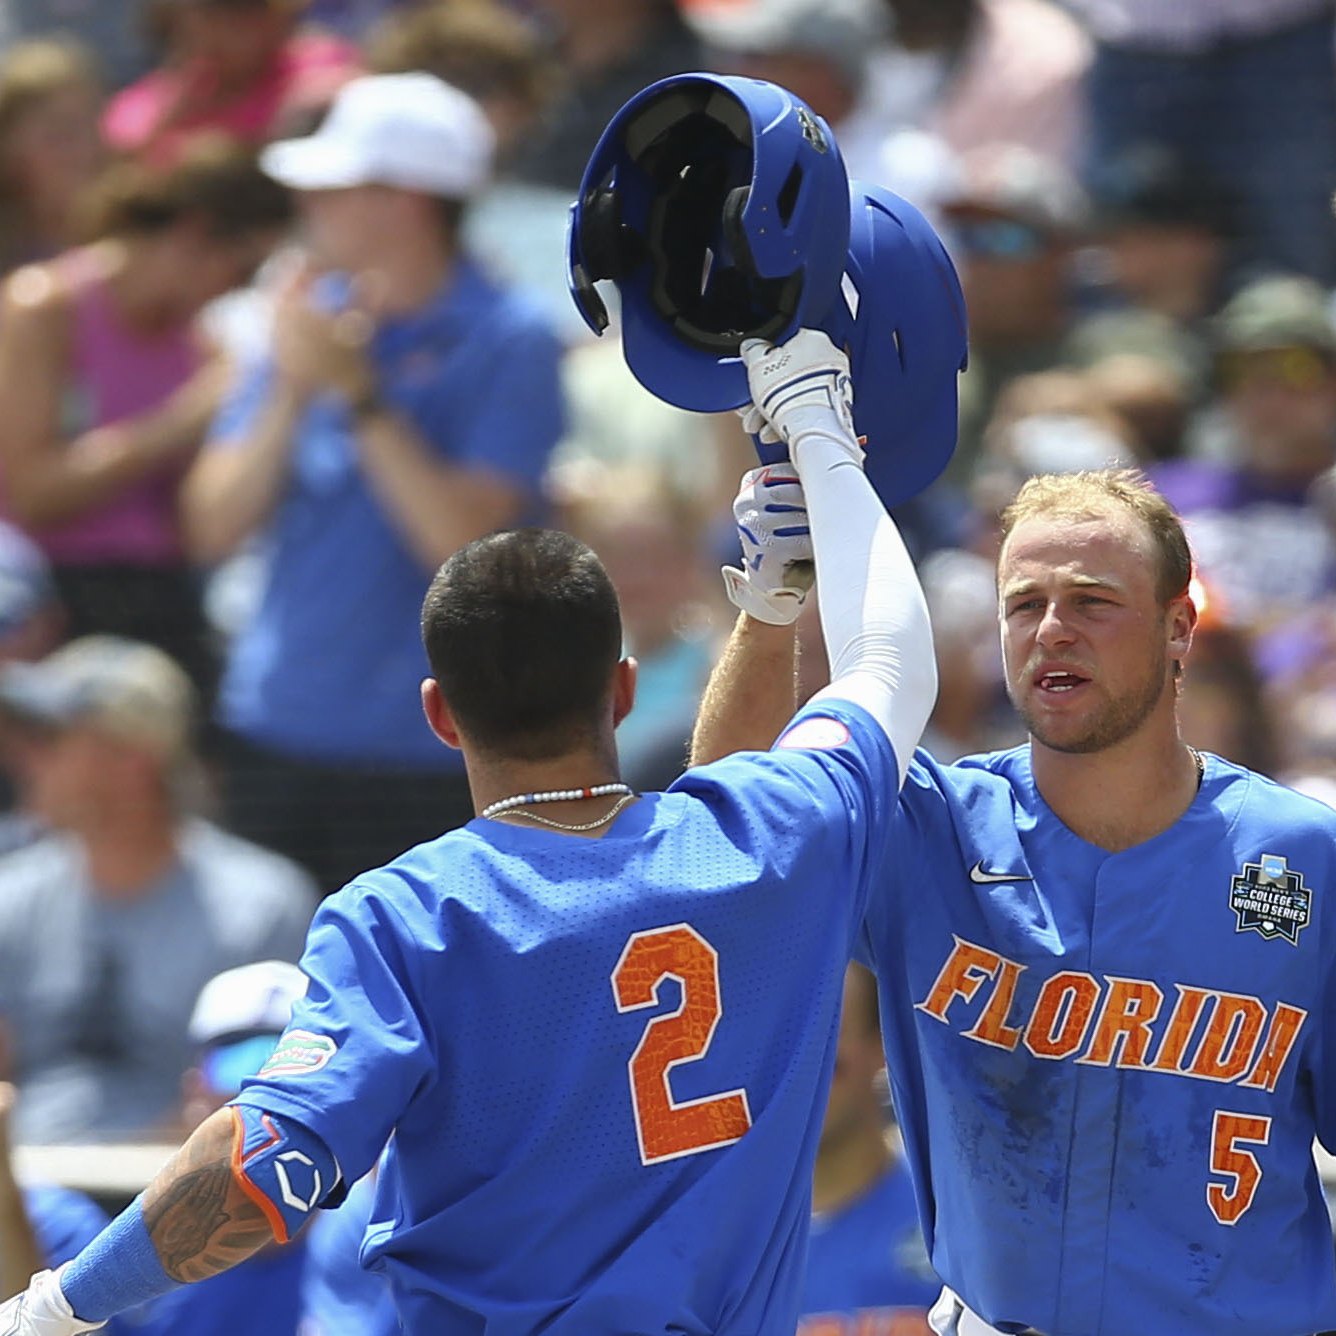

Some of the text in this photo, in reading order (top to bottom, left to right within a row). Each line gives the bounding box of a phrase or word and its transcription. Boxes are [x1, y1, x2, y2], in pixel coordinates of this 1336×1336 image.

[1233, 897, 1307, 922] WORLD SERIES
[1249, 889, 1293, 907] COLLEGE
[610, 922, 753, 1166] 2
[914, 934, 1308, 1093] FLORIDA
[1206, 1110, 1273, 1226] 5
